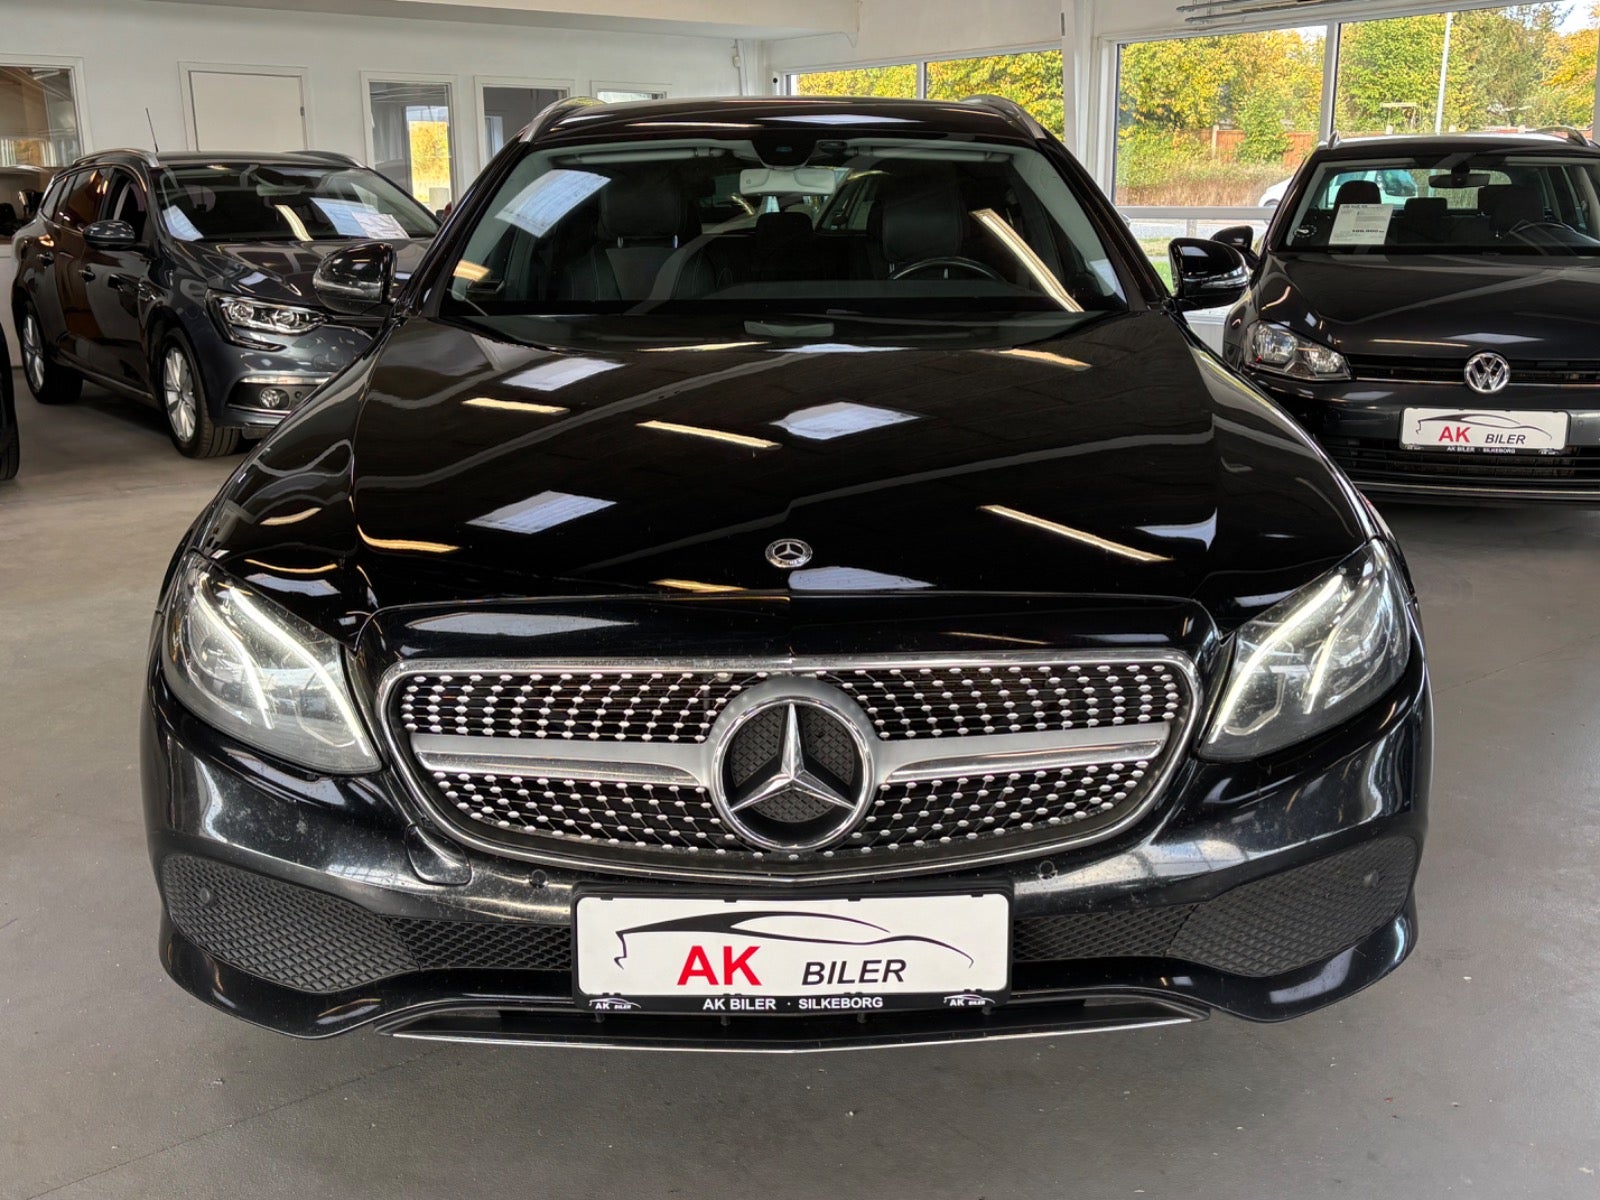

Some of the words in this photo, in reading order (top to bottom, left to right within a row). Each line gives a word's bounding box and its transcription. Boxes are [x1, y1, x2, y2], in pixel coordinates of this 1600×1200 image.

[1466, 353, 1509, 392] VW
[1438, 426, 1471, 443] AK
[1485, 433, 1526, 445] BILER
[677, 945, 763, 986] AK
[801, 958, 908, 986] BILER
[595, 1002, 610, 1010] AK
[702, 998, 725, 1010] AK
[730, 998, 777, 1010] BILER
[798, 997, 883, 1009] SILKEBORG
